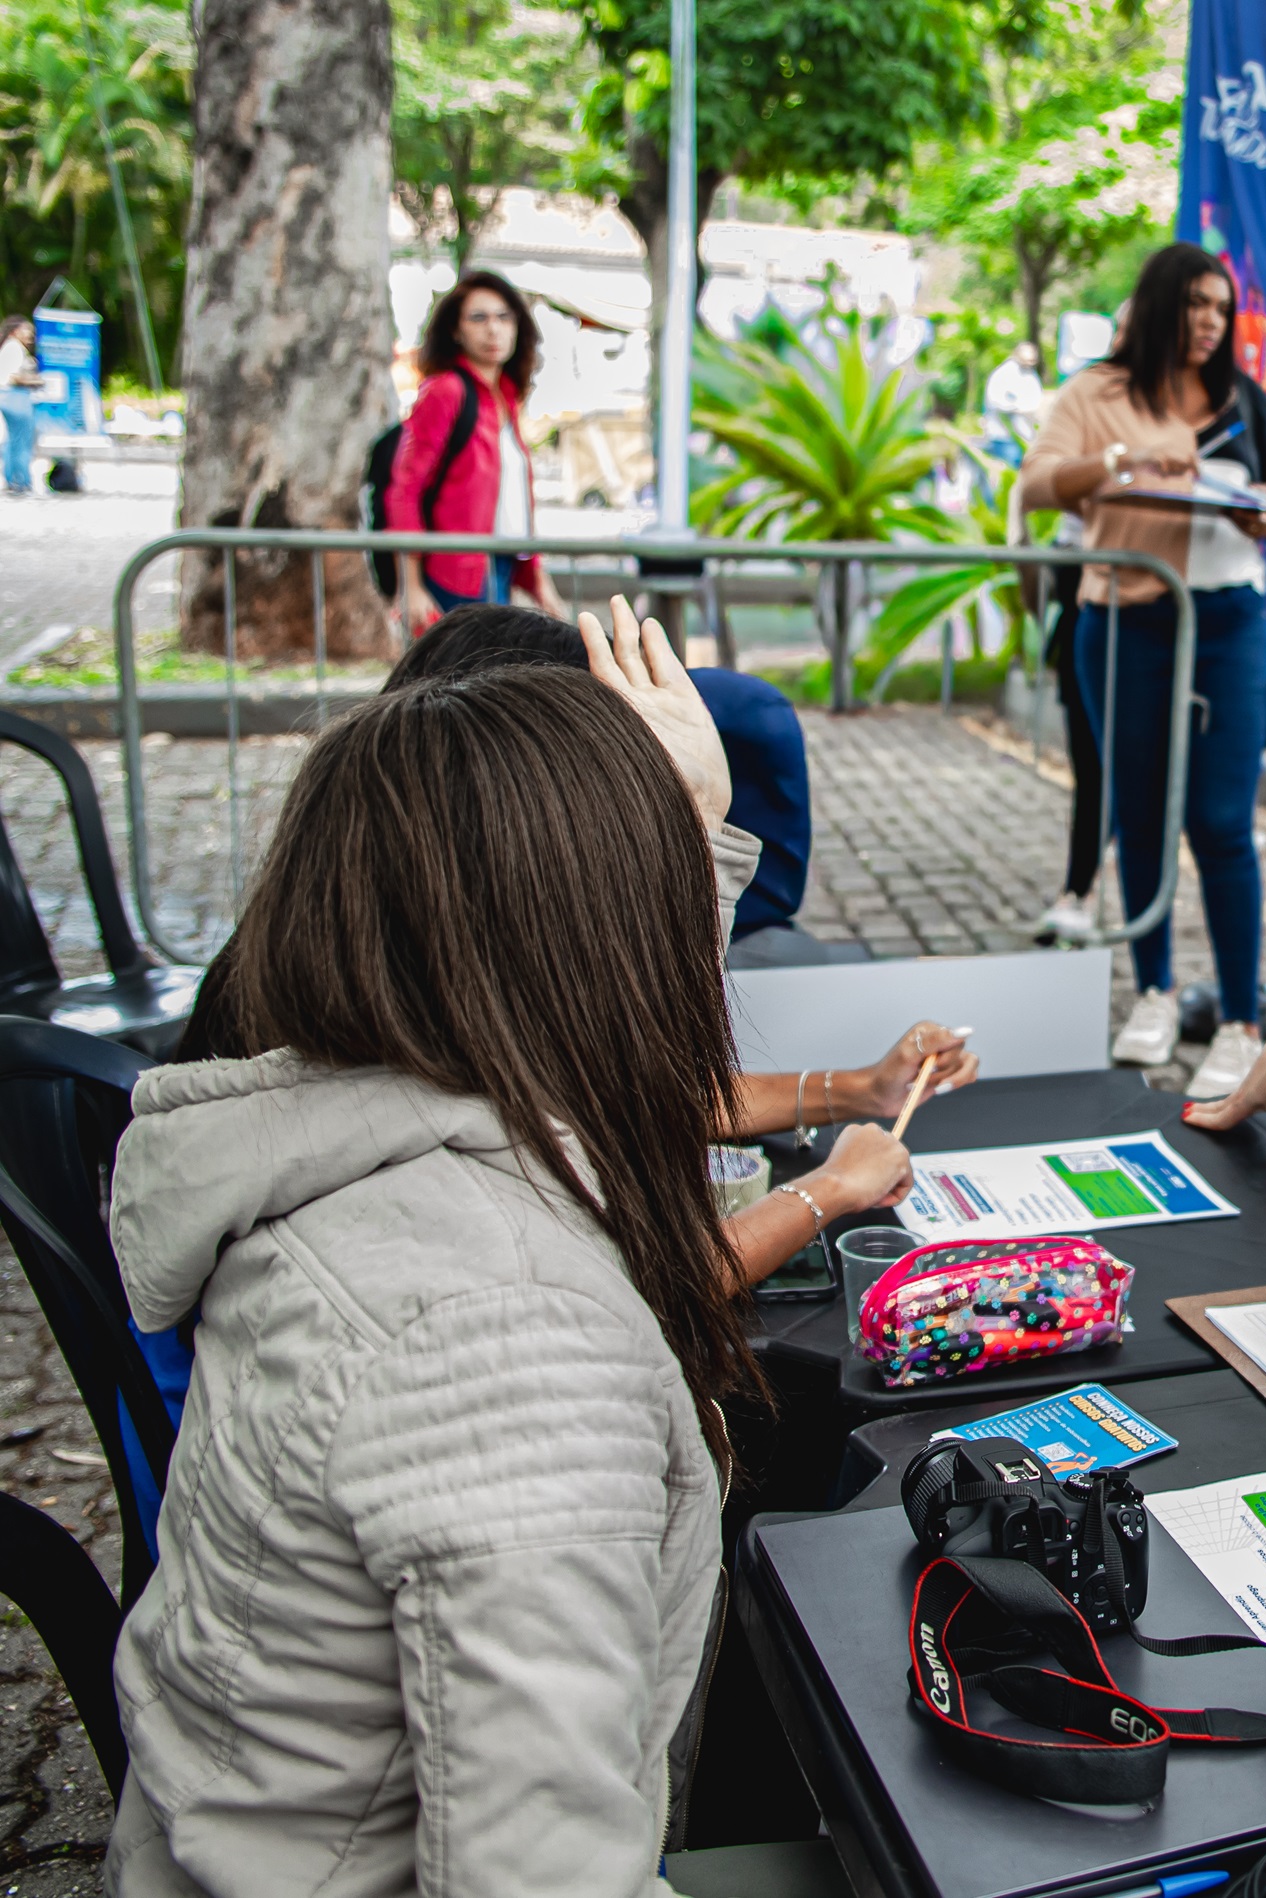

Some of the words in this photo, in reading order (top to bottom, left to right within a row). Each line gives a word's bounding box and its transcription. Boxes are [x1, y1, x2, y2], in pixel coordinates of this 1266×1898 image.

[1069, 1395, 1107, 1421] CURSOS
[1098, 1419, 1148, 1452] GRATUITOS
[1087, 1393, 1128, 1423] CONHEÇA
[1125, 1418, 1161, 1444] NOSSOS
[1235, 1595, 1259, 1619] Aprendiz
[920, 1622, 951, 1714] Canon
